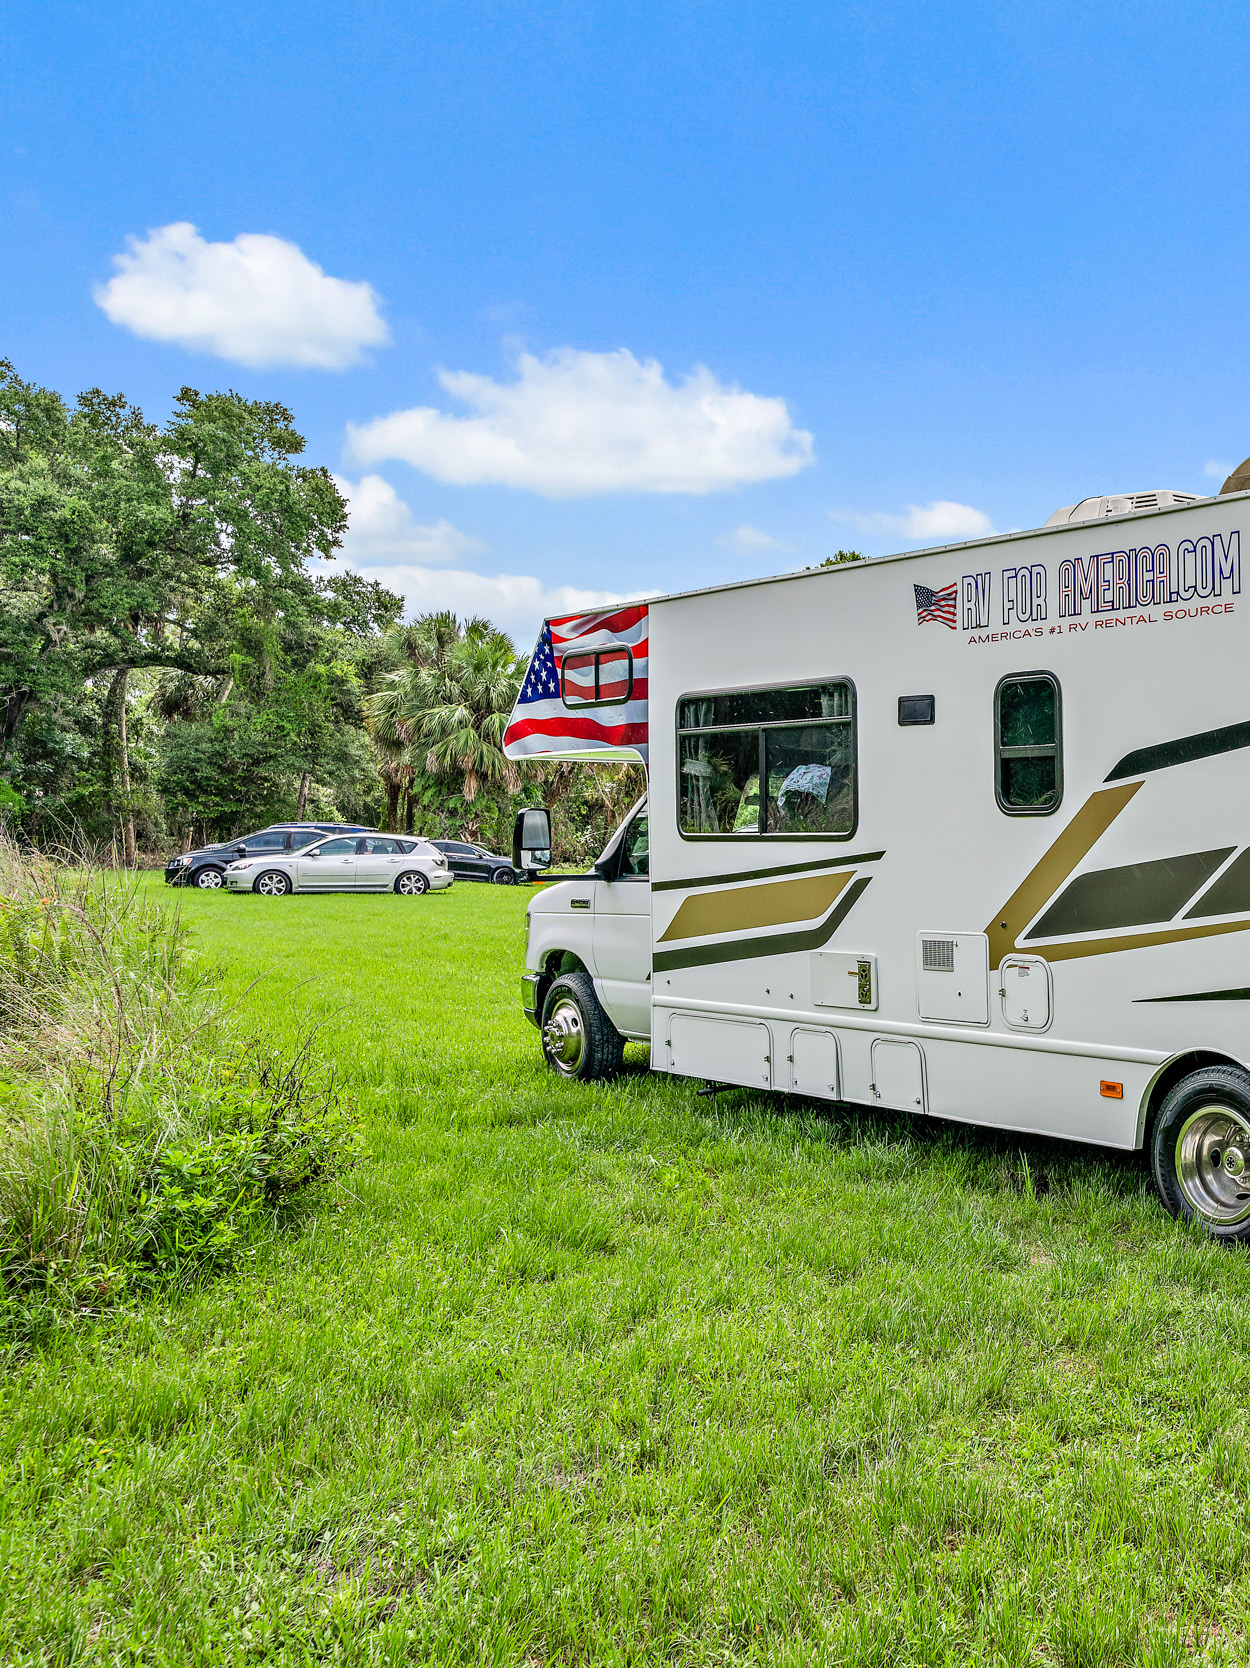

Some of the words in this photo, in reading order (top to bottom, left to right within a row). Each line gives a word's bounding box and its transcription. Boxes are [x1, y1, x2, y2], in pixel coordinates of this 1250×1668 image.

[962, 572, 991, 630] RV
[1002, 564, 1047, 625] FOR
[1059, 531, 1241, 618] AMERICA.COM
[968, 627, 1044, 645] AMERICA'S
[1048, 625, 1063, 636] #1
[1069, 621, 1089, 632] RV
[1095, 614, 1157, 630] RENTAL
[1163, 602, 1235, 621] SOURCE
